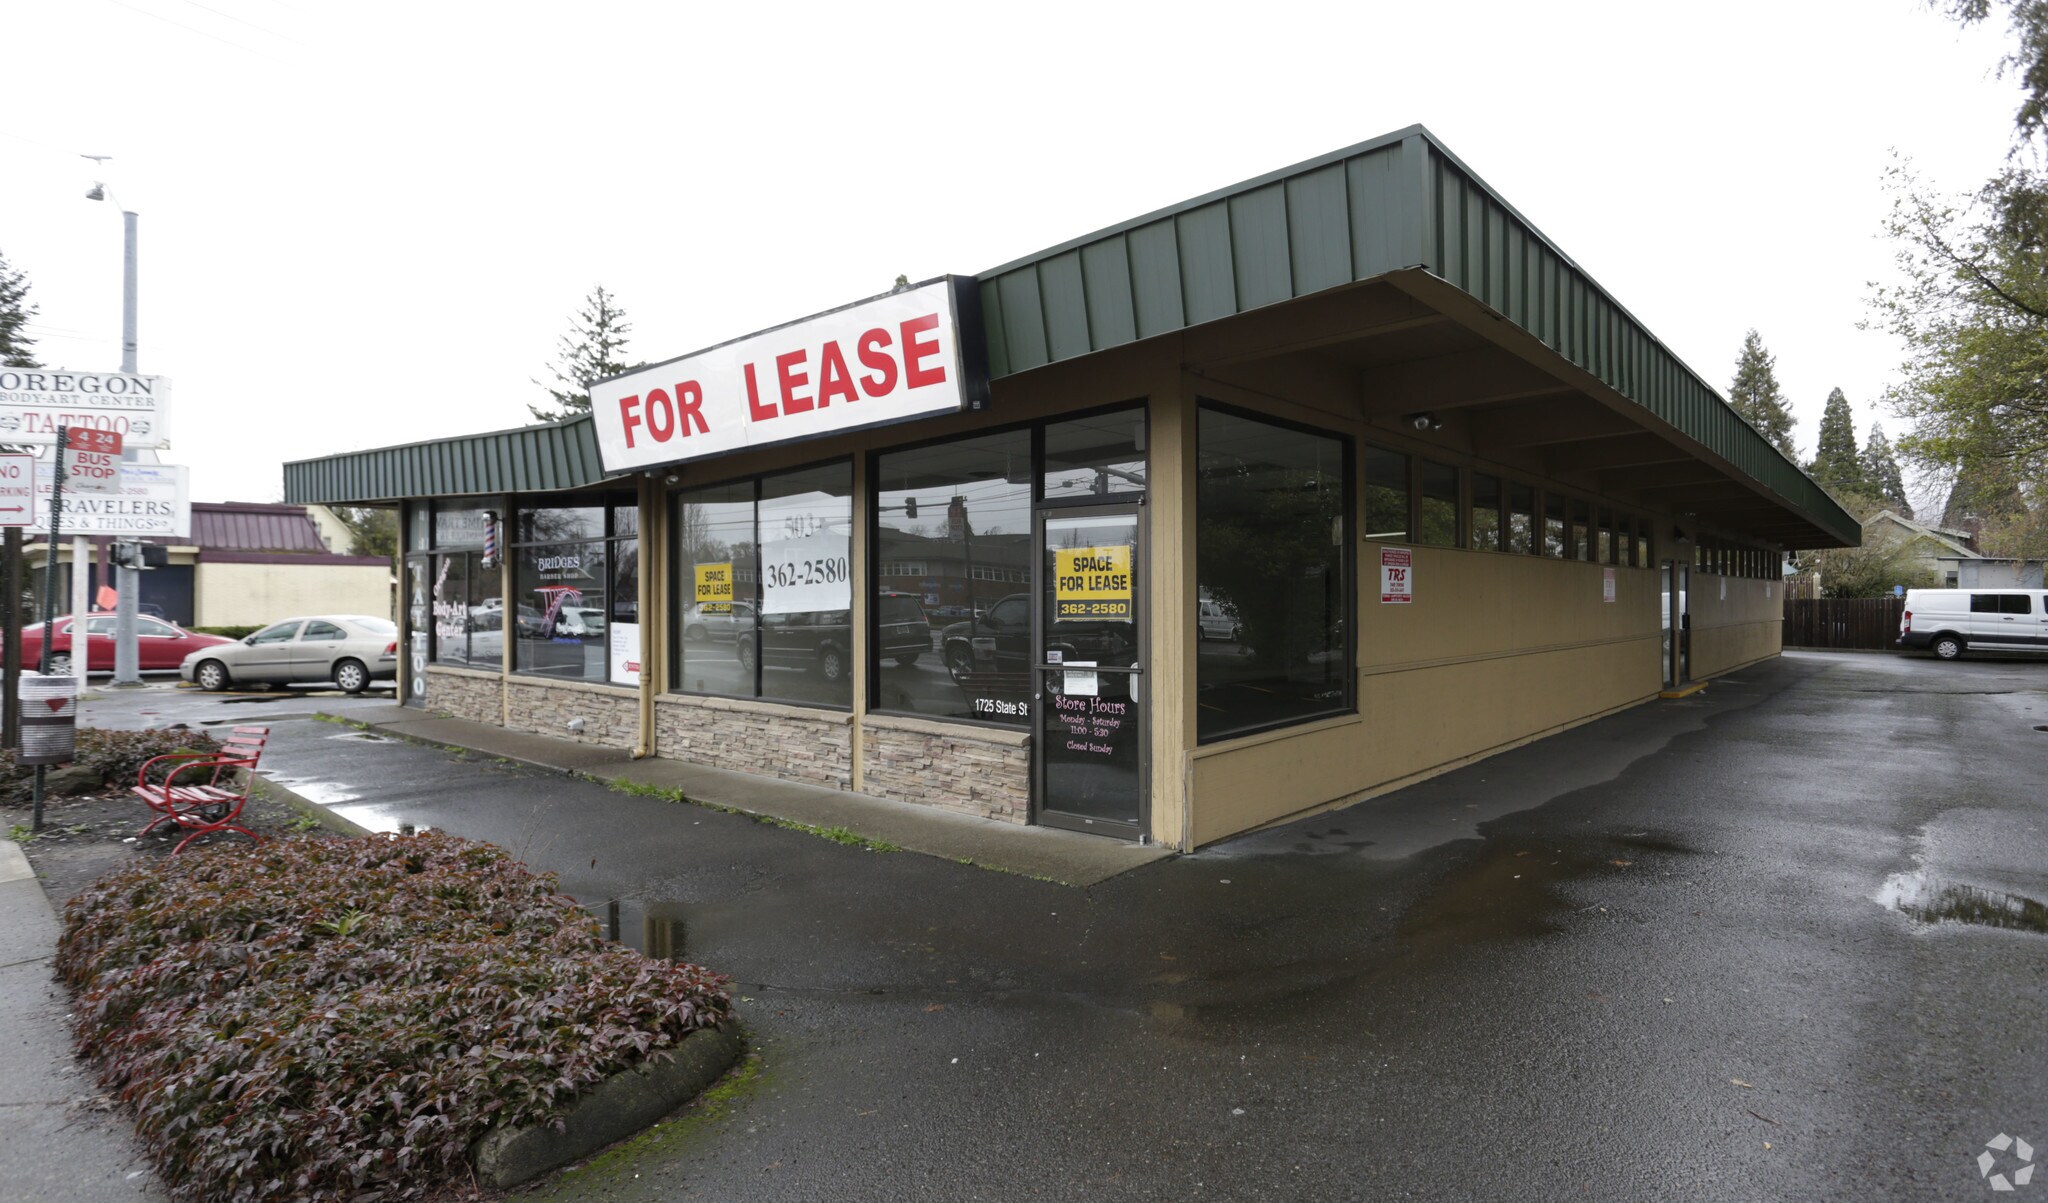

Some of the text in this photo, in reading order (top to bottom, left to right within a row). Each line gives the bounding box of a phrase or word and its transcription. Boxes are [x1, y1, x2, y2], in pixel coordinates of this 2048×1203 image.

[0, 372, 154, 395] OREGON
[619, 312, 947, 449] FOR LEASE
[0, 392, 156, 407] BODY-ART CENTER
[23, 412, 129, 437] TATTOO
[78, 431, 114, 444] 4 24
[77, 452, 111, 467] BUS
[0, 465, 20, 479] NO
[71, 465, 115, 479] STOP
[0, 486, 30, 497] RKING
[43, 499, 170, 515] TRAVELERS
[79, 517, 89, 528] &
[96, 517, 154, 529] THINGS
[538, 556, 580, 571] BRIDGES
[1073, 555, 1113, 573] SPACE
[705, 570, 725, 582] SPACE
[767, 557, 847, 589] 362-2580
[1388, 568, 1406, 582] TRS
[698, 584, 731, 596] FOR LEASE
[1059, 574, 1128, 592] FOR LEASE
[433, 601, 467, 619] Body-Art
[1061, 603, 1127, 614] 362-2580
[412, 565, 425, 696] TATTOO
[975, 698, 1028, 716] 1725 State St
[1055, 694, 1126, 715] Store Hours
[1060, 714, 1085, 725] Monday
[1092, 716, 1121, 728] Saturday
[1067, 740, 1113, 755] Closed Sunday
